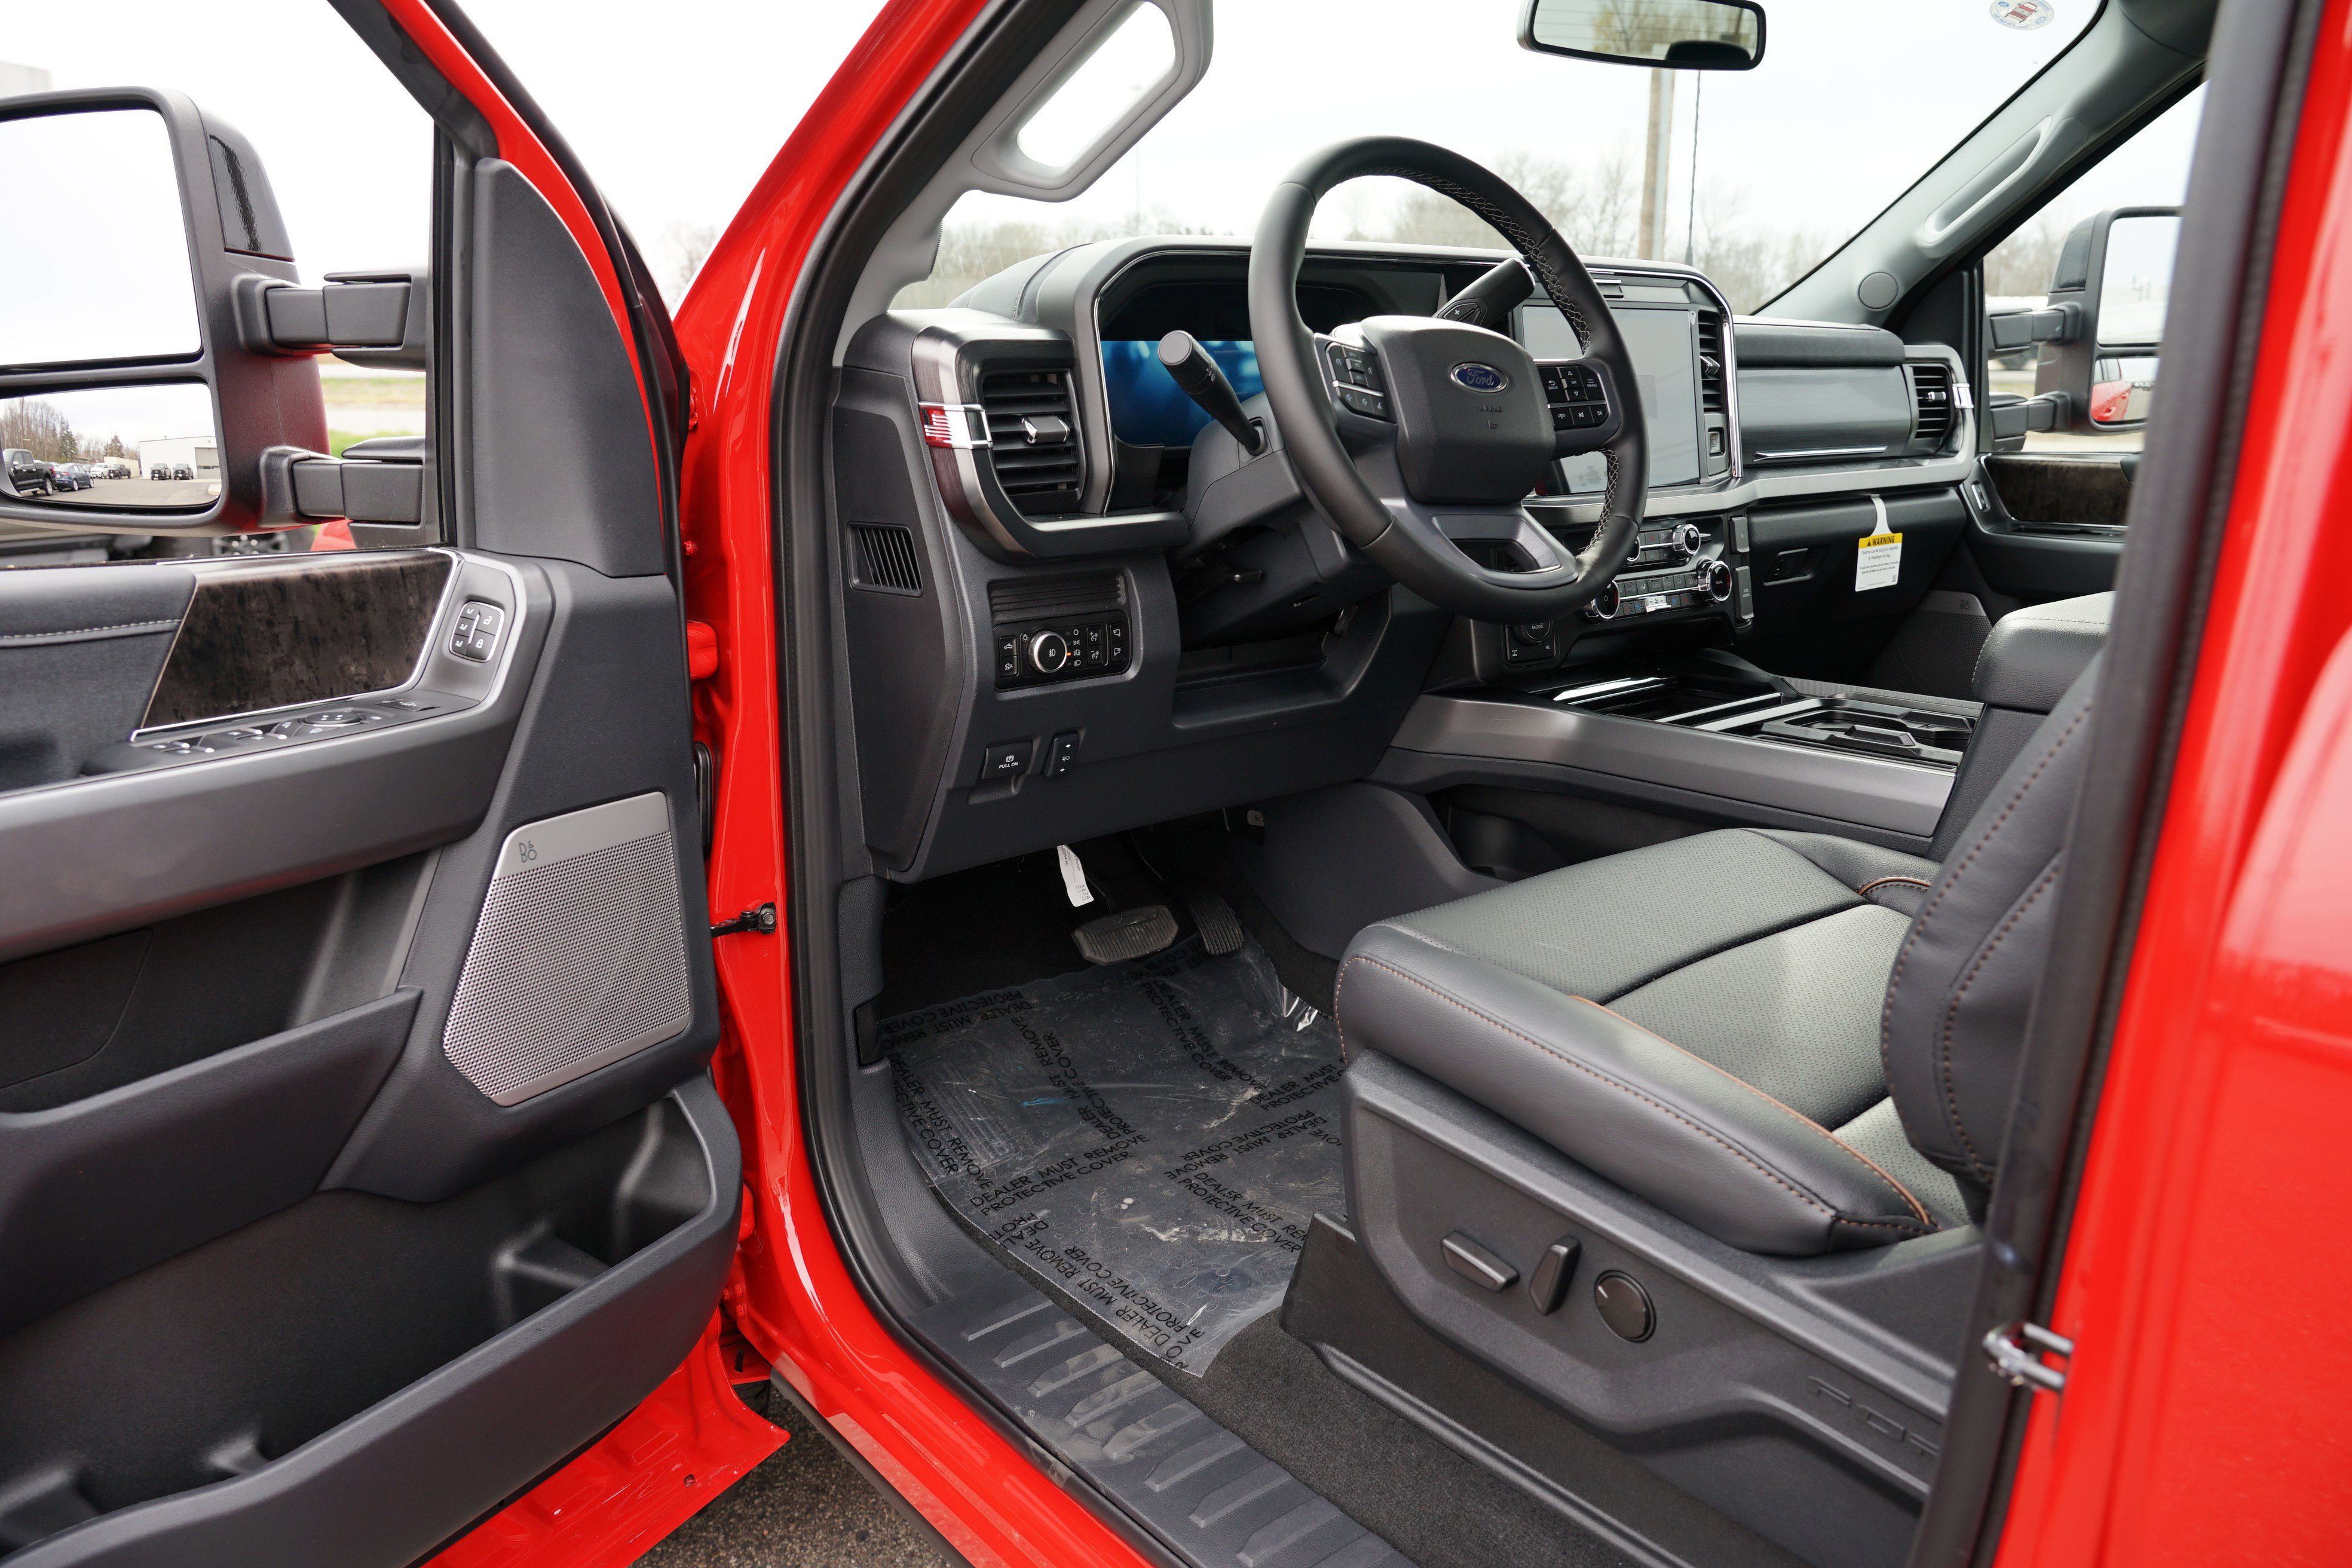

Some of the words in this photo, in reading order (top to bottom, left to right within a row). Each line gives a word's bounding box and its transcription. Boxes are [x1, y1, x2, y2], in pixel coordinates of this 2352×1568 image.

[1466, 368, 1495, 386] Ford
[1872, 535, 1895, 546] WARNING
[938, 990, 1024, 1016] PROTECTIVE
[981, 1000, 1033, 1021] DEALER
[883, 1012, 936, 1034] COVER
[883, 1028, 927, 1050] REMO
[934, 1015, 972, 1034] MUST
[1140, 982, 1196, 1052] PROTECTIVE
[1192, 1052, 1232, 1082] COVER
[1153, 979, 1190, 1021] DEALER
[1188, 1026, 1218, 1058] MUST
[1217, 1058, 1267, 1092] REMOVE
[1011, 1016, 1054, 1067] REMOVE
[1043, 1033, 1077, 1079] COVER
[1049, 1075, 1081, 1100] MUST
[1248, 1080, 1301, 1105] DEALER
[1301, 1063, 1337, 1083] MUST
[1260, 1074, 1340, 1111] PROTECTIVE
[887, 1052, 925, 1096] DEALER
[920, 1100, 953, 1132] MUST
[947, 1137, 995, 1190] REMOVE
[1072, 1080, 1136, 1135] PROTECTIVE
[1077, 1105, 1122, 1140] DEALER
[1232, 1110, 1316, 1143] PROTECTIVE
[1275, 1116, 1328, 1139] DEALER
[920, 1129, 959, 1174] COVER
[1179, 1141, 1233, 1162] COVER
[1233, 1136, 1272, 1154] MUST
[969, 1175, 1033, 1208] DEALER
[1038, 1157, 1079, 1178] MUST
[1083, 1135, 1150, 1161] REMOVE
[980, 1171, 1077, 1216] PROTECTIVE
[1077, 1150, 1134, 1175] COVER
[1163, 1153, 1229, 1180] REMOVE
[1177, 1178, 1255, 1224] PROTECTIVE
[1251, 1223, 1302, 1253] COVER
[1194, 1172, 1244, 1202] DEALER
[1242, 1202, 1283, 1223] MUST
[1024, 1239, 1080, 1278] REMOVE
[1064, 1245, 1111, 1279] COVER
[1077, 1278, 1117, 1306] MUST
[1107, 1278, 1188, 1333] PROTECTIVE
[1116, 1305, 1171, 1347] DEALER
